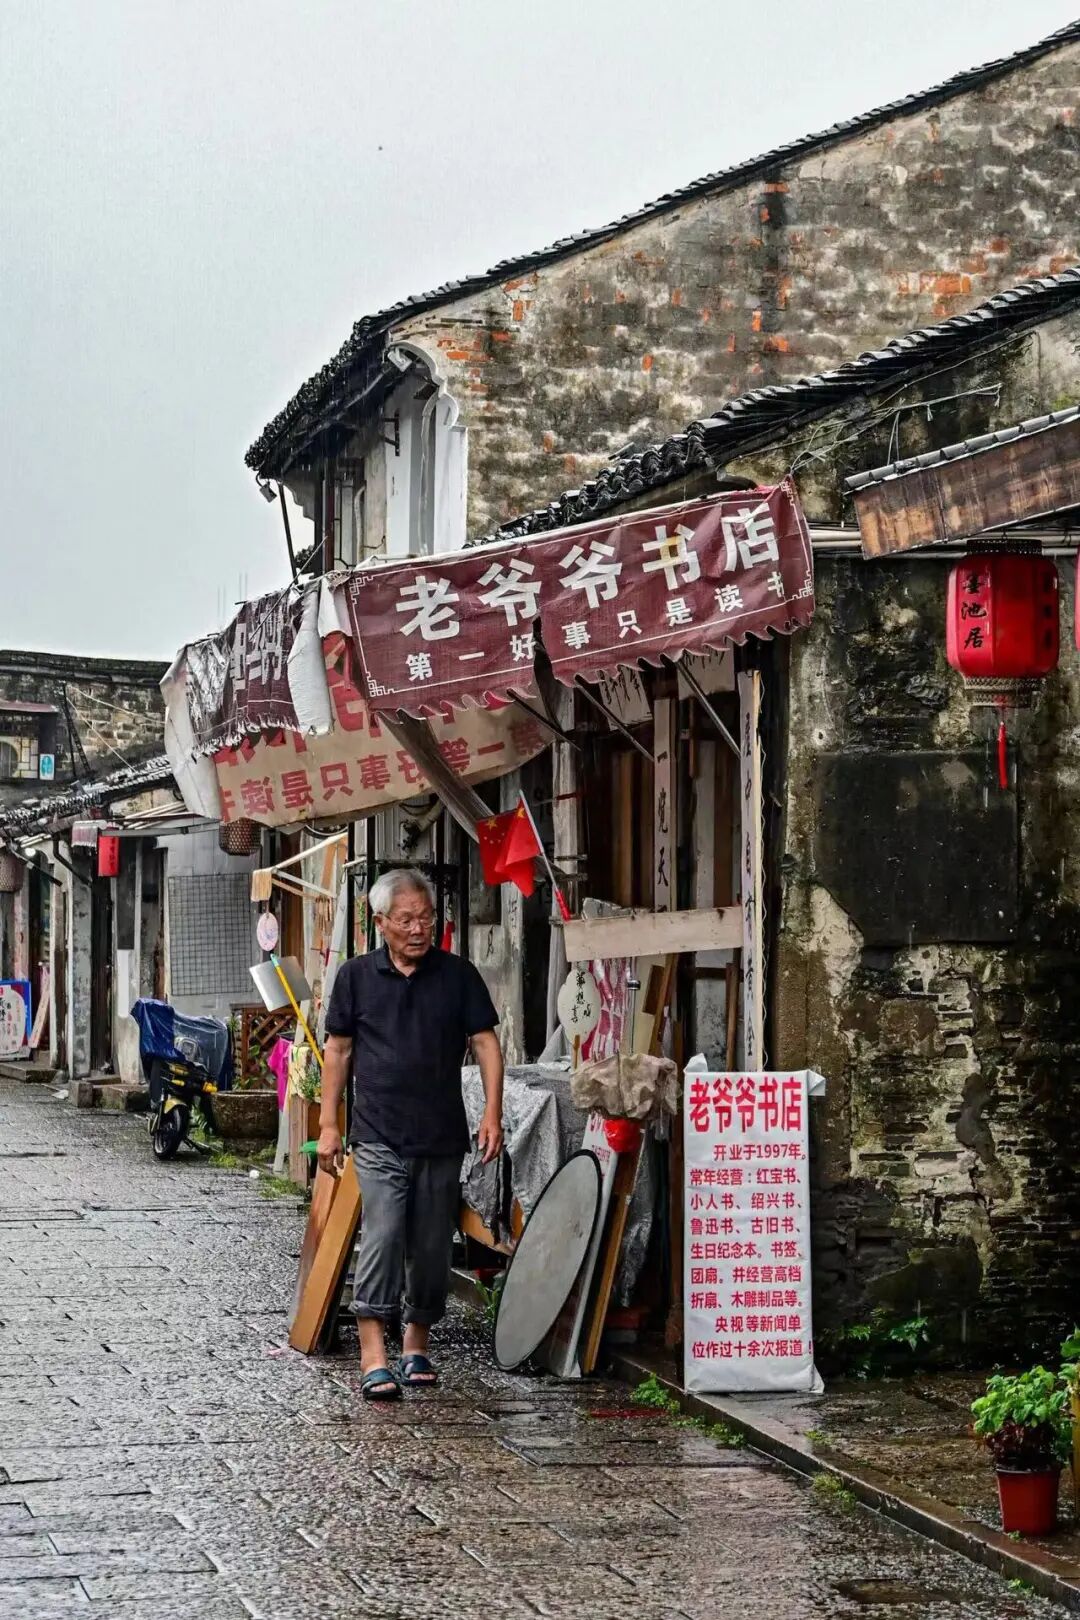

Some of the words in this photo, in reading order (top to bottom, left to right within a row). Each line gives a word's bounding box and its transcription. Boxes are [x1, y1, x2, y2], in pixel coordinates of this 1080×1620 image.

[395, 503, 781, 641] 老爷爷书店
[405, 571, 785, 682] 第一好事只是读书
[690, 1077, 803, 1133] 老爷爷书店
[714, 1144, 806, 1160] 开业于1997年。
[715, 1313, 802, 1333] 央视等新闻单
